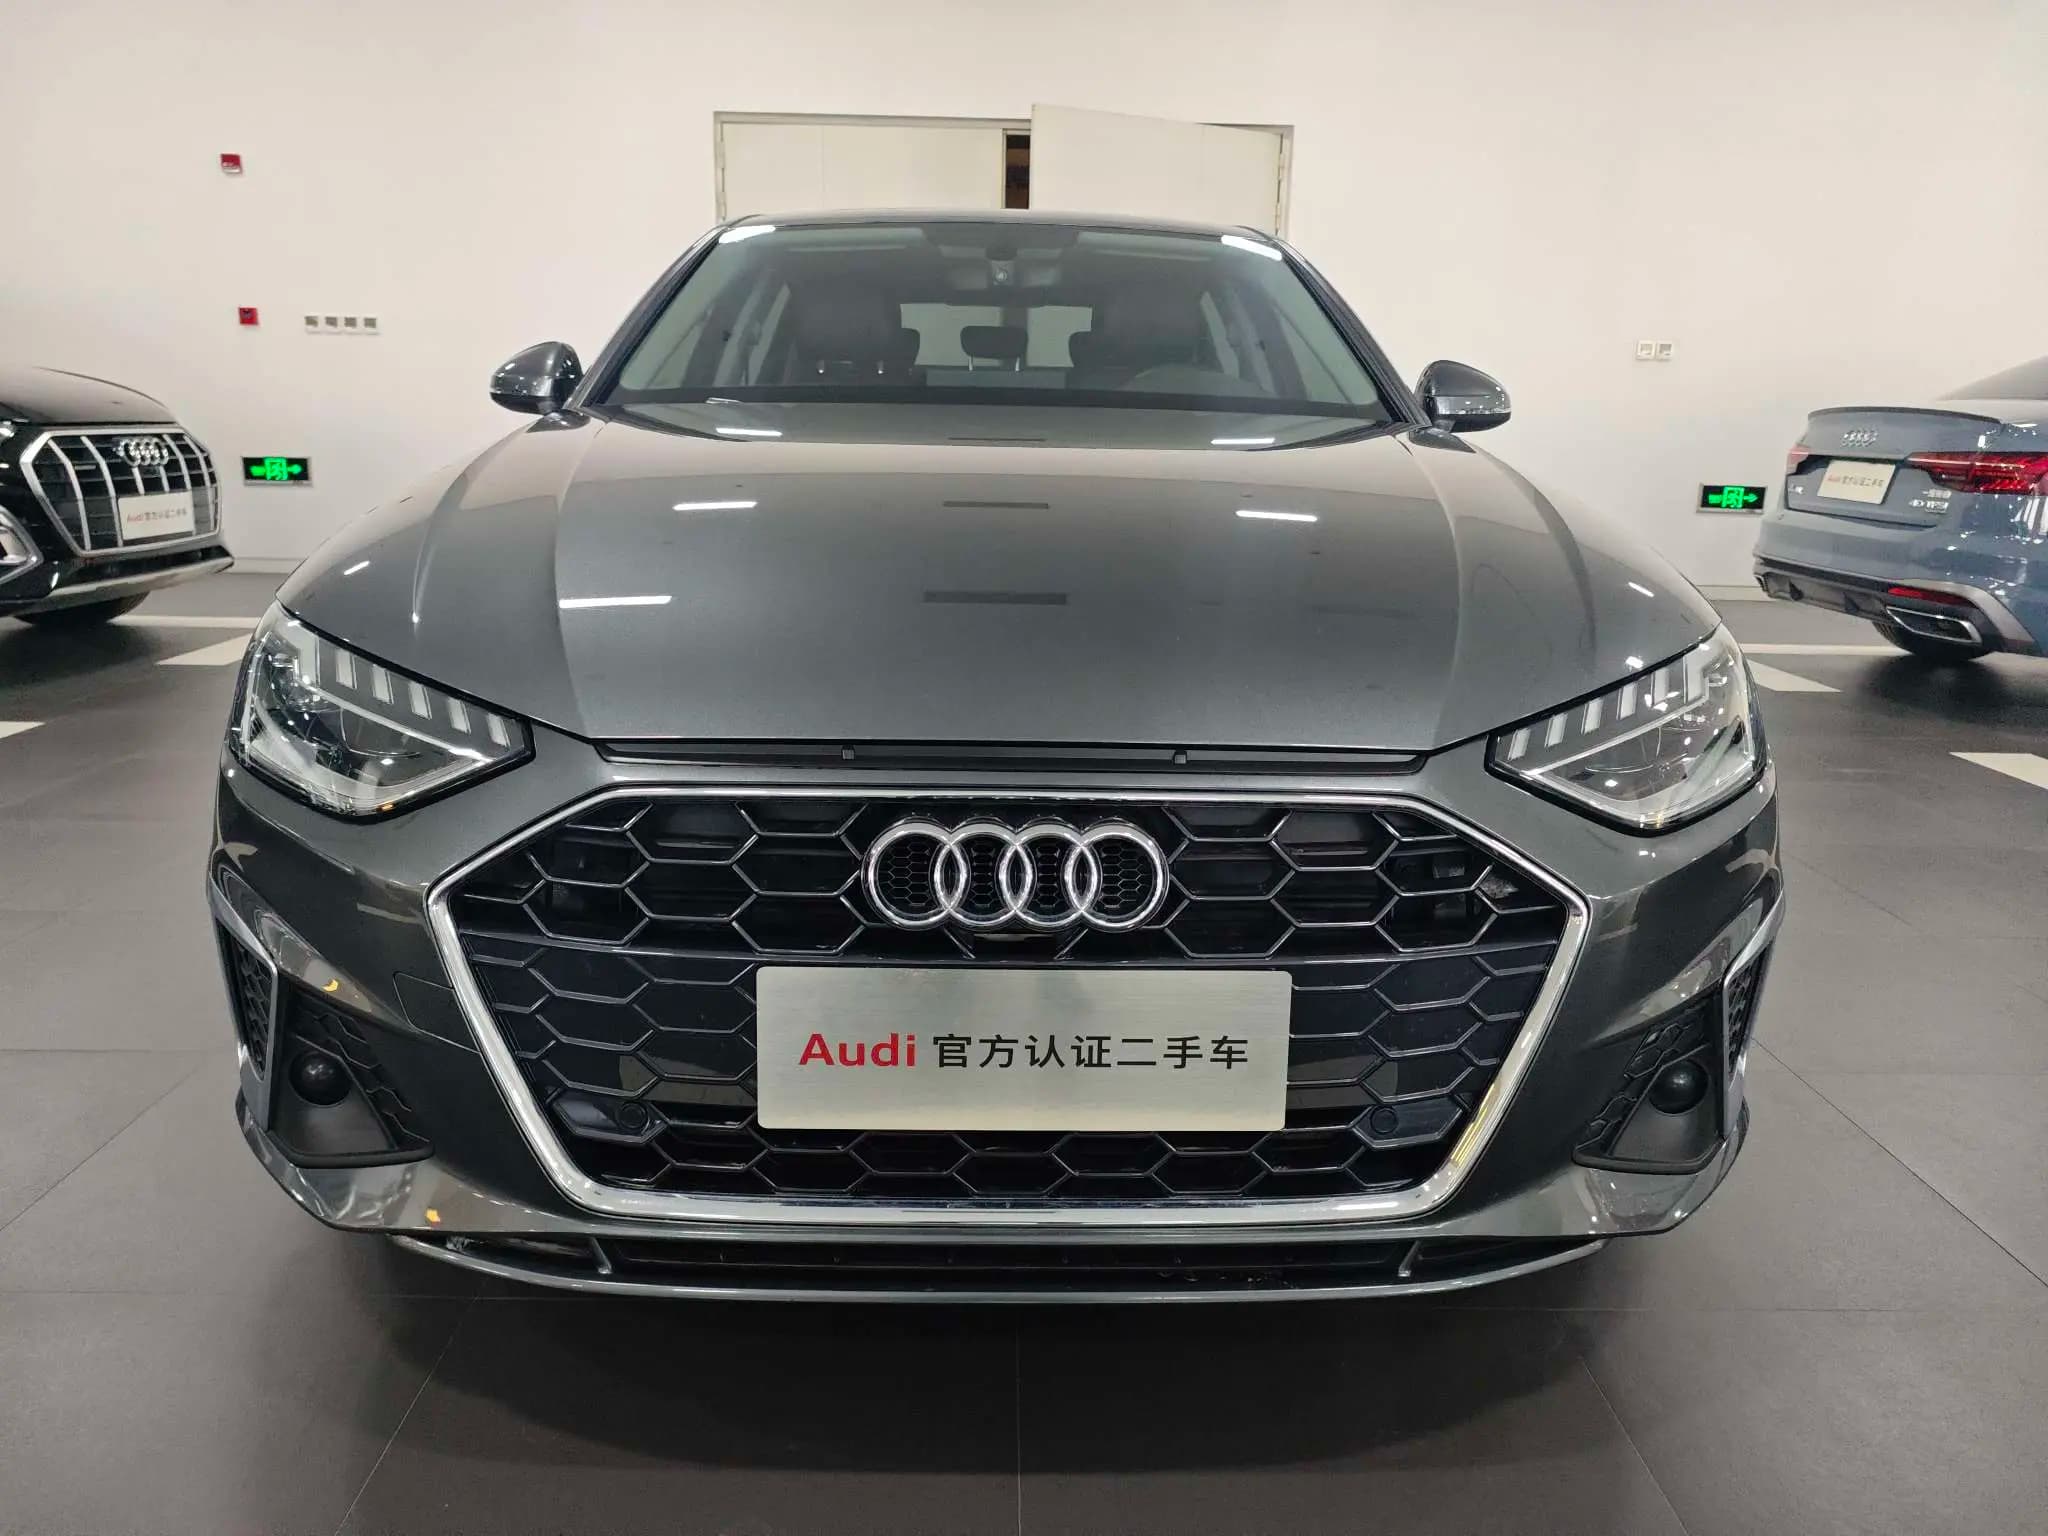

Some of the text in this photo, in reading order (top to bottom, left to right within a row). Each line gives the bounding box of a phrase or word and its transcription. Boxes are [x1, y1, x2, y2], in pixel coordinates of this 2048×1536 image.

[799, 1033, 1249, 1070] Audi 官方认证二手车
